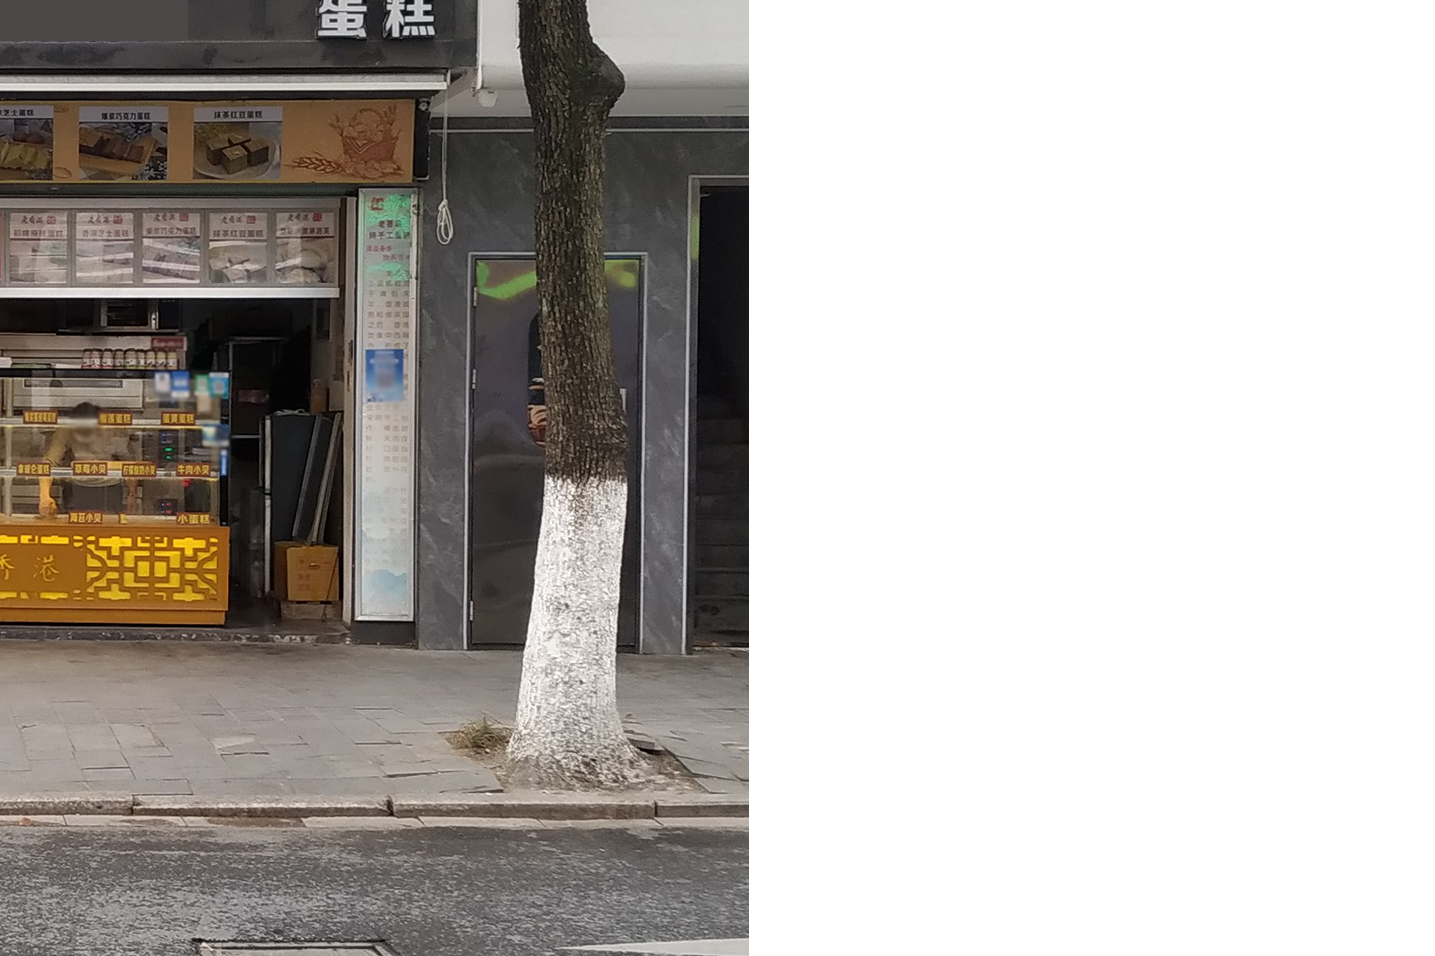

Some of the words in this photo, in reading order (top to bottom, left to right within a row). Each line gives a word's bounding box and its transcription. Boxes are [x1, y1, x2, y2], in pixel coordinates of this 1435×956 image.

[214, 110, 263, 119] 抹茶红豆蛋糕
[74, 464, 107, 474] 草莓小贝
